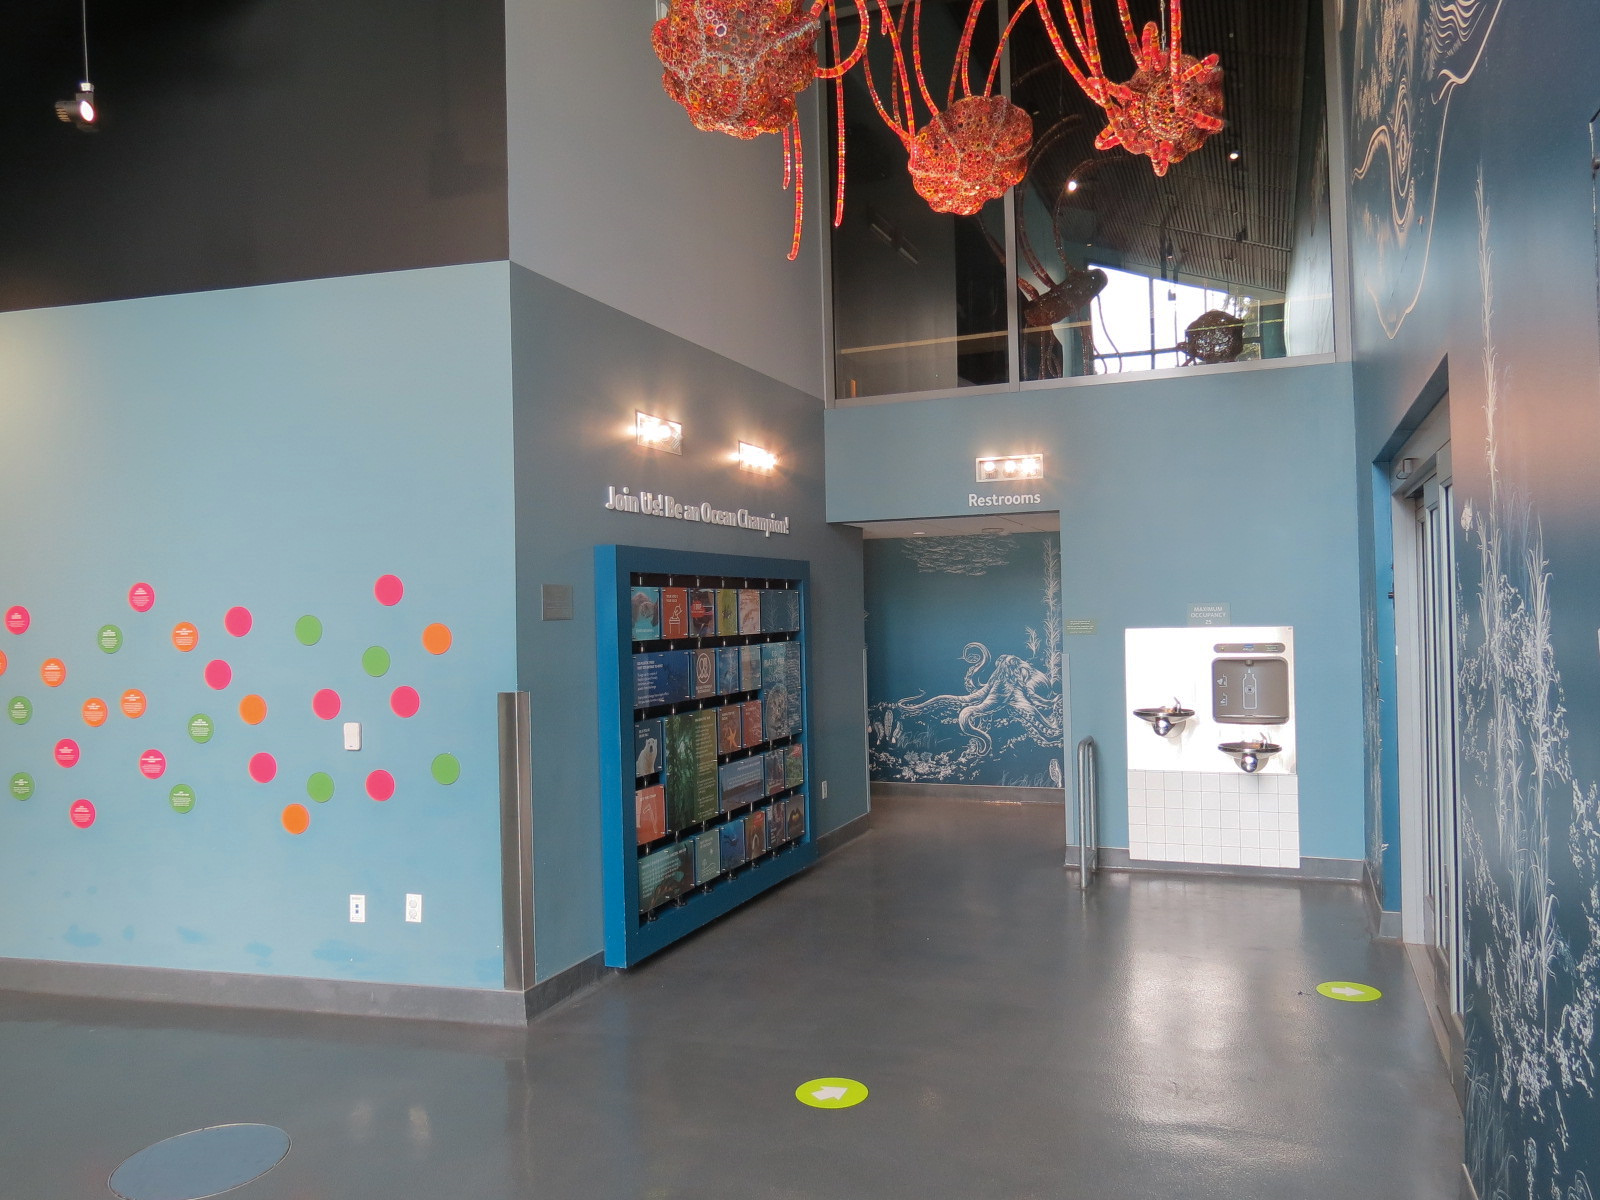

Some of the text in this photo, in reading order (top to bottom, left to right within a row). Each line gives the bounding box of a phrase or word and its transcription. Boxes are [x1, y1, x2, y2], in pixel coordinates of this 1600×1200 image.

[605, 485, 790, 538] Join Us! Be an Ocean Champion!
[968, 493, 1041, 507] Restrooms
